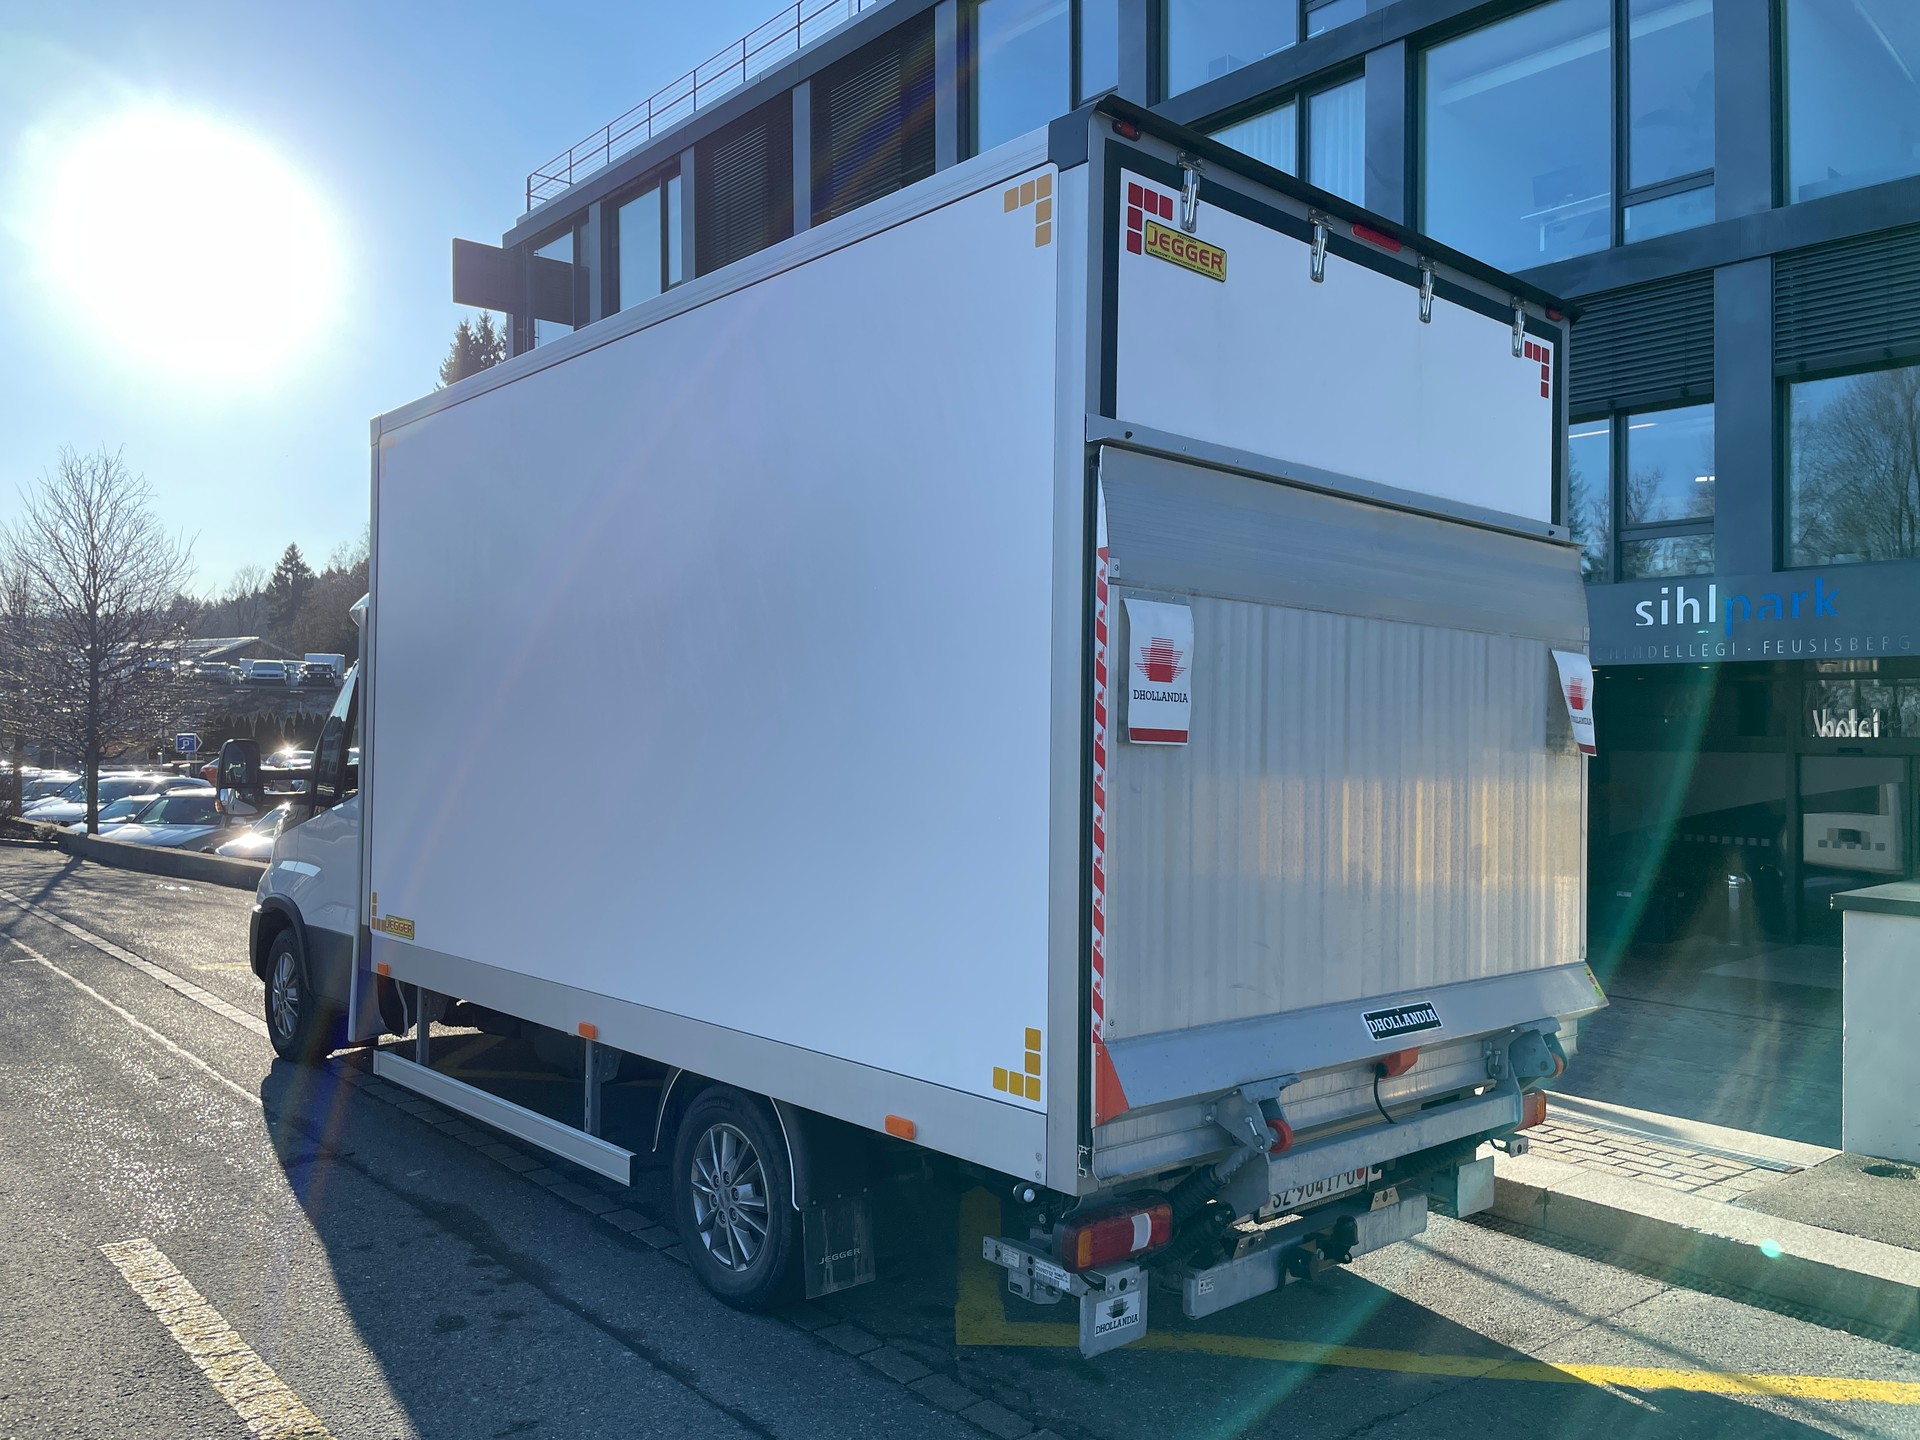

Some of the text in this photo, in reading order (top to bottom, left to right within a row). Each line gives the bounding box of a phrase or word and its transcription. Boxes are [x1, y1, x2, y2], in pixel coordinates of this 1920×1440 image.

[1147, 228, 1224, 273] JEGGER
[1635, 577, 1840, 637] sihlpark
[1763, 635, 1911, 655] FEUSISBERG
[1133, 689, 1189, 703] DHOLLANDIA
[385, 918, 413, 934] JEGGER
[1367, 1008, 1438, 1033] DHOLLANDIA
[818, 1247, 861, 1265] JEGGER
[1095, 1313, 1139, 1335] DHOLLANDIA
